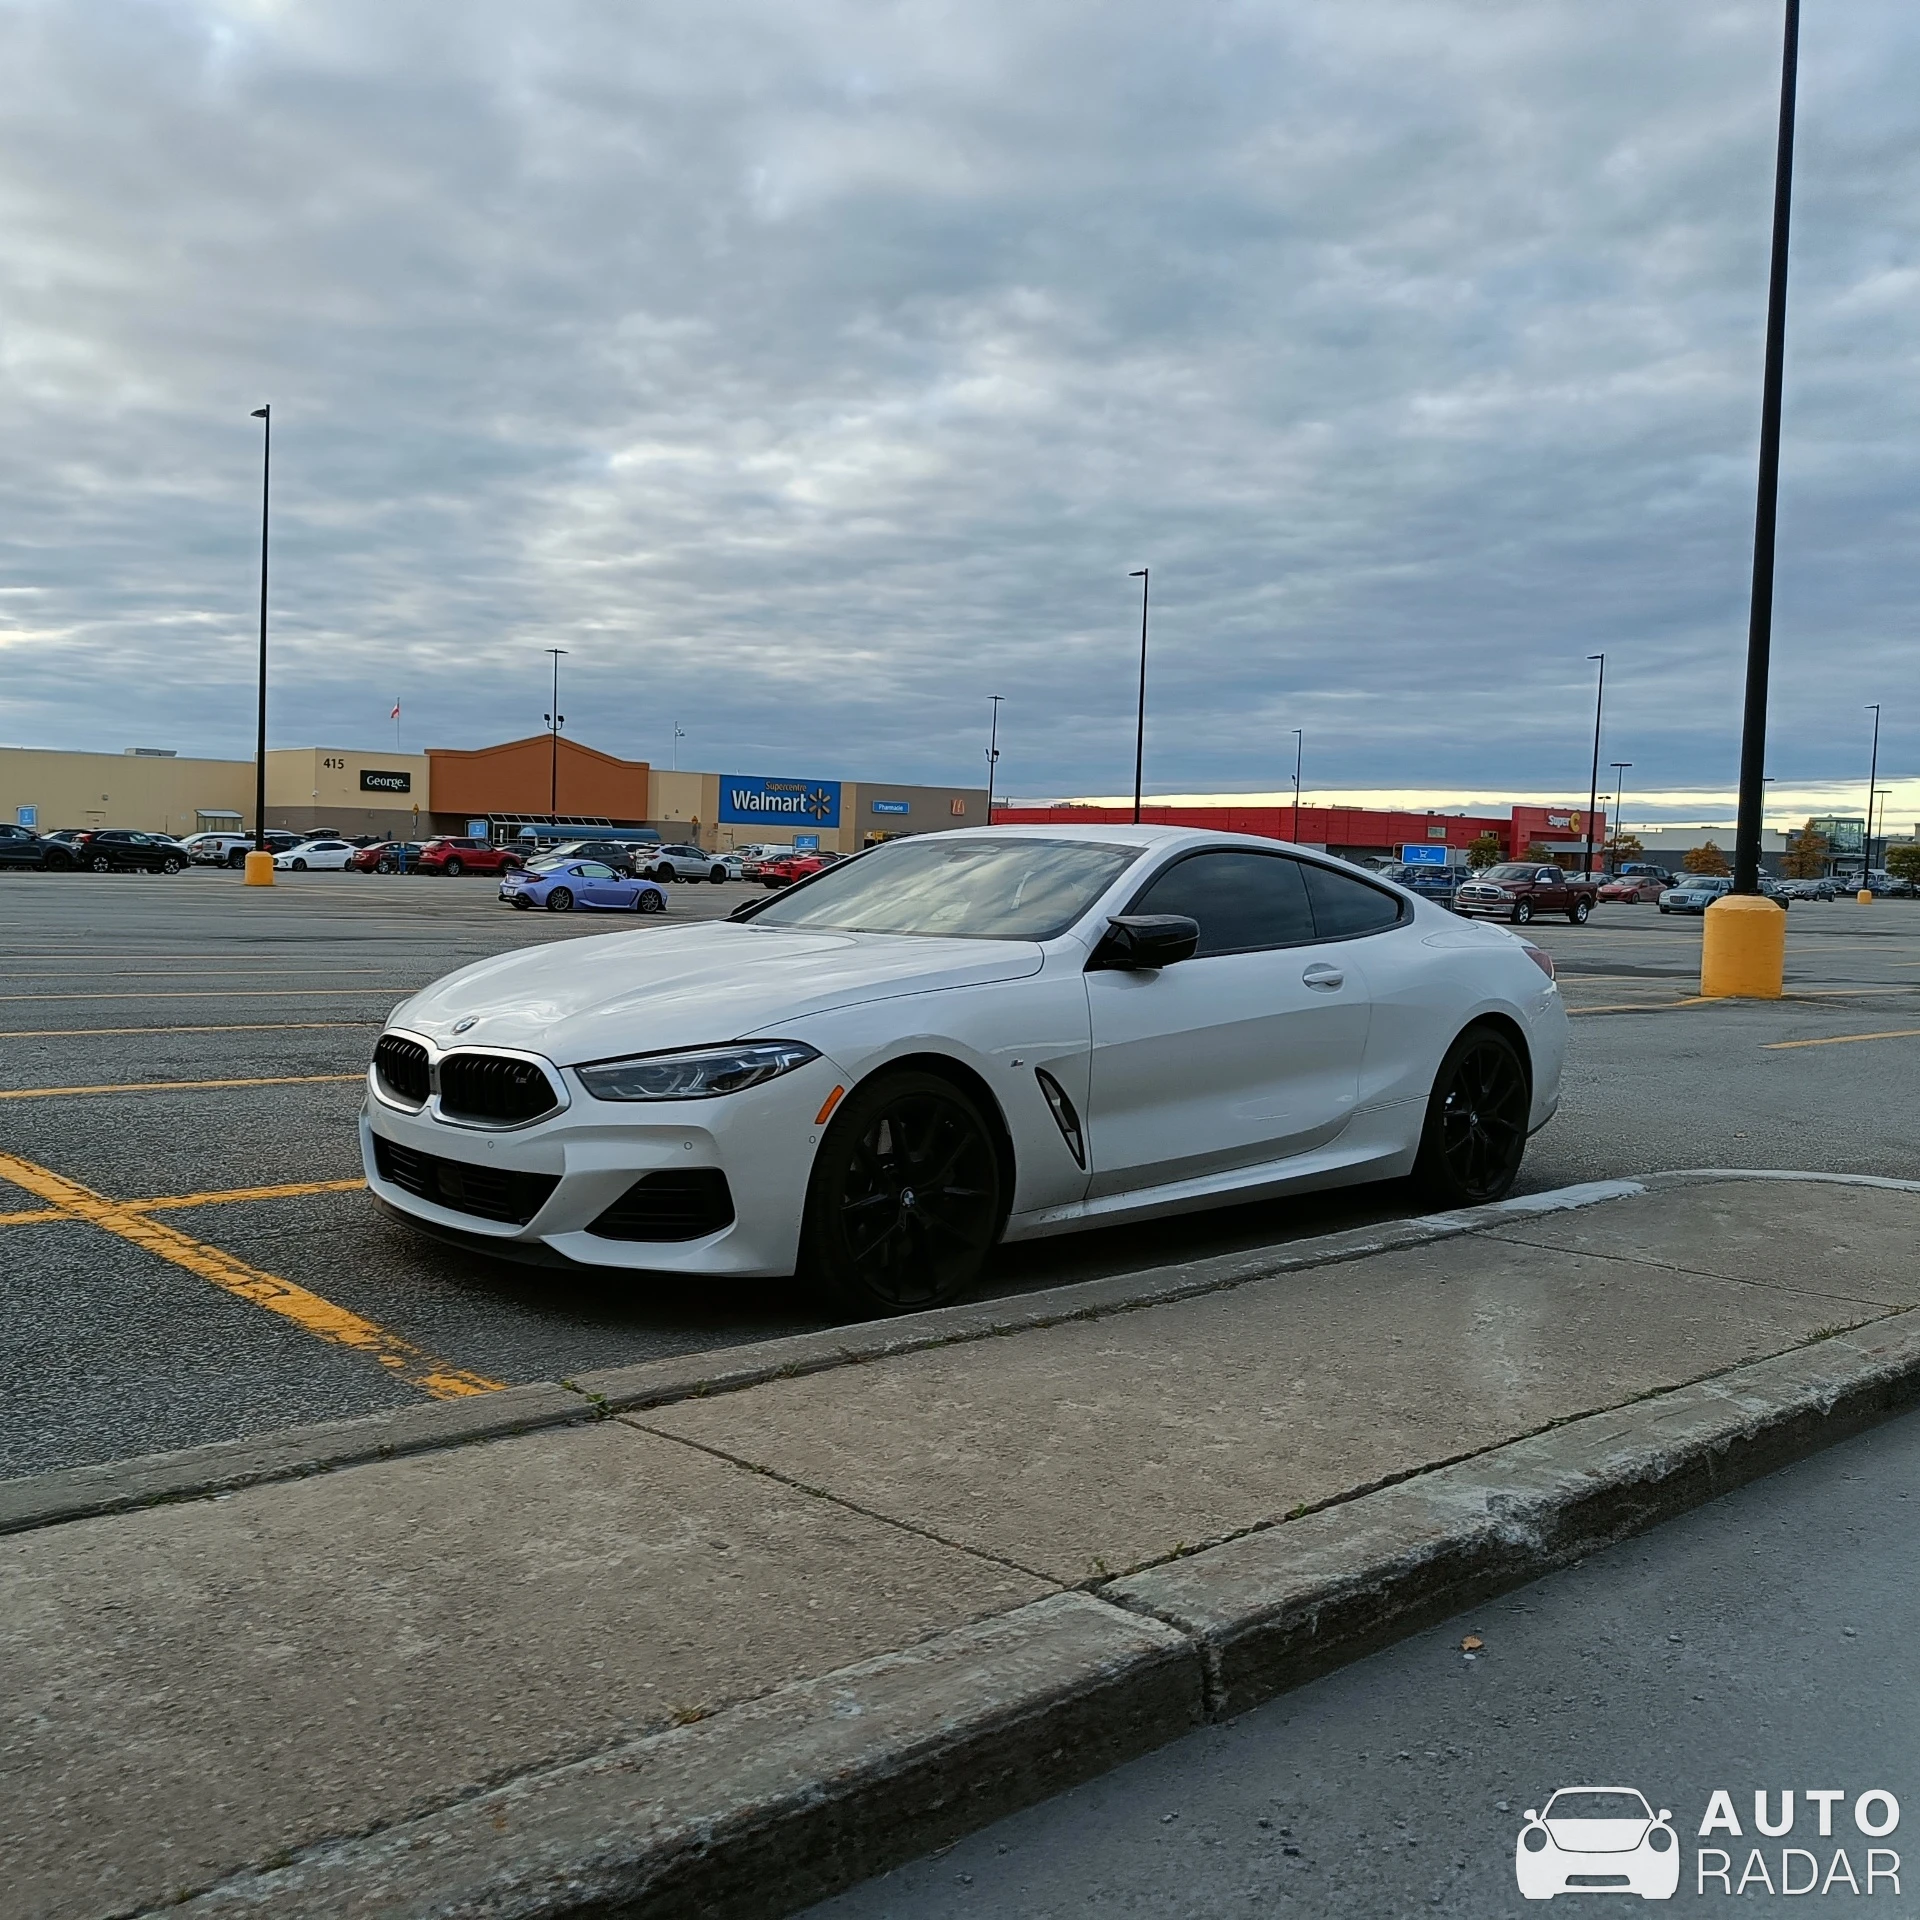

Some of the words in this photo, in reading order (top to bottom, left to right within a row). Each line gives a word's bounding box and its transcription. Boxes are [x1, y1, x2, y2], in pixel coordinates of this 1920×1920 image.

[324, 758, 344, 769] 415
[765, 780, 807, 793] Supercentre
[731, 789, 807, 813] Walmart
[878, 803, 904, 812] Pharmacie
[1548, 815, 1571, 829] Super
[1570, 812, 1581, 833] C
